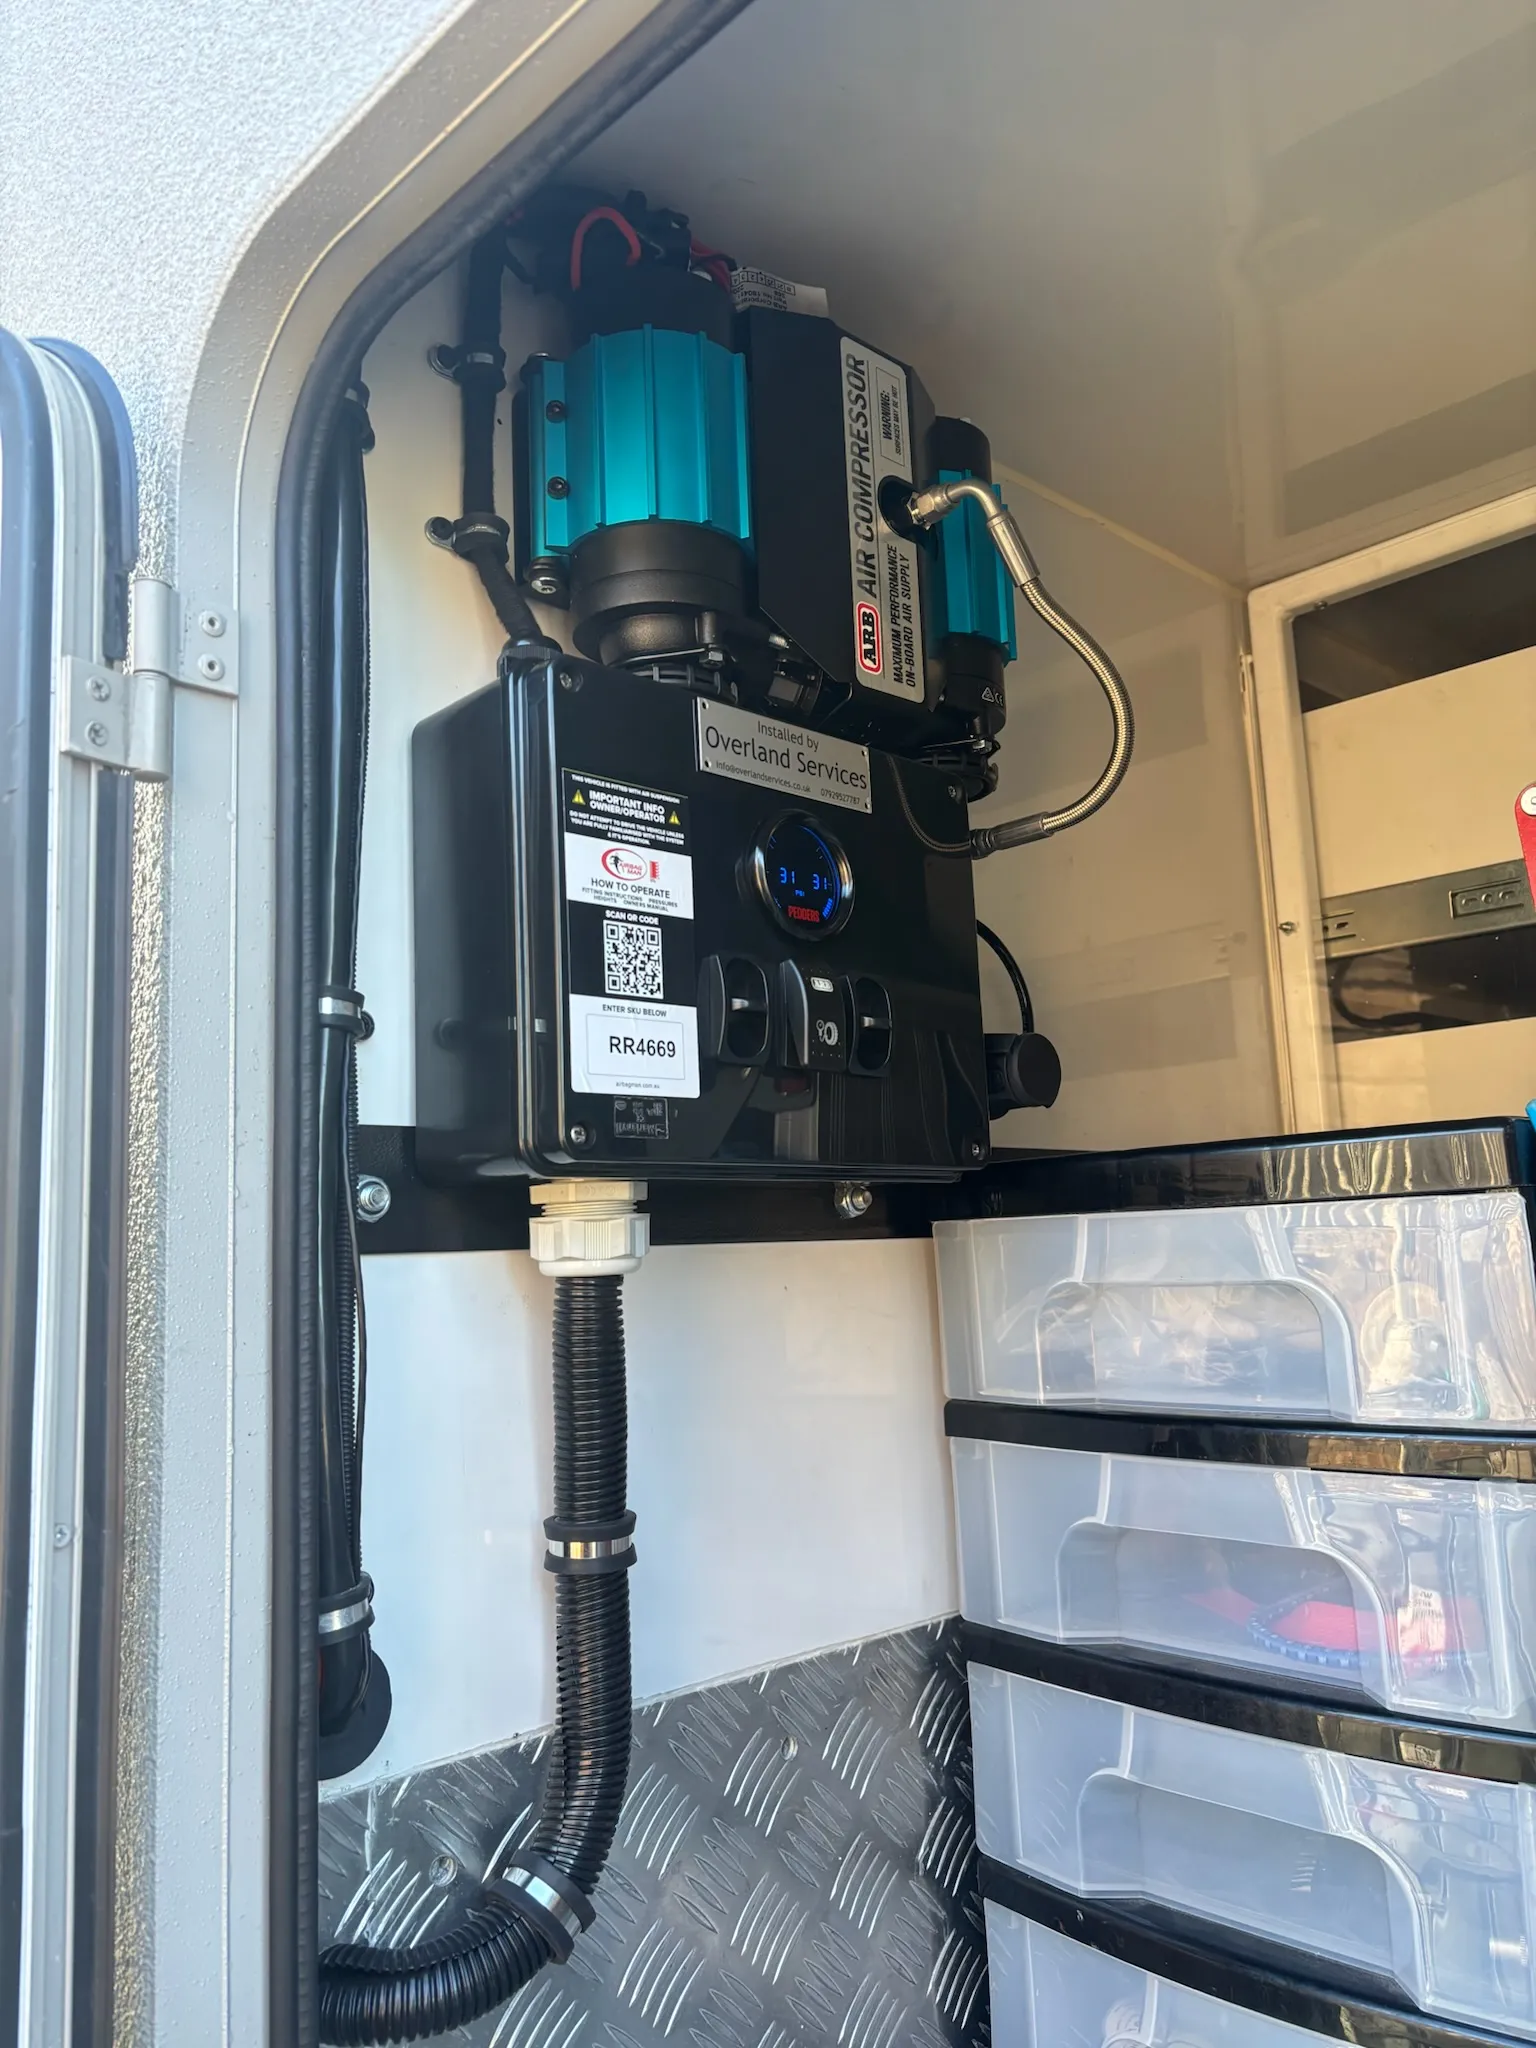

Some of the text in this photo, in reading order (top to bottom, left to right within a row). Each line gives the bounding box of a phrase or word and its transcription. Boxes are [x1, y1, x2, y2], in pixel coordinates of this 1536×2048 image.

[773, 301, 787, 311] ARB
[891, 385, 899, 397] HOT
[880, 390, 892, 441] WARNING:
[892, 407, 900, 422] MAY
[894, 424, 902, 455] SURFACES
[846, 353, 877, 666] ARB AIR COMPRESSOR
[887, 544, 904, 684] MAXIMUM PERFORMANCE
[900, 553, 916, 687] ON-BOARD AIR SUPPLY
[757, 720, 819, 752] Installed by
[706, 726, 867, 790] Overland Services
[571, 774, 584, 783] THIS
[585, 776, 605, 788] VEHICLE
[611, 783, 628, 792] FITTED
[629, 786, 641, 795] WITH
[642, 789, 650, 797] AIR
[589, 789, 665, 815] IMPORTANT INFO
[589, 800, 665, 824] OWNER/OPERATOR
[571, 817, 582, 825] YOU
[583, 819, 593, 828] ARE
[593, 821, 609, 831] FULLY
[643, 831, 655, 839] WITH
[655, 834, 665, 842] THE
[665, 835, 684, 845] SYSTEM
[578, 812, 590, 820] NOT
[590, 813, 613, 825] ATTEMPT
[613, 818, 620, 826] TO
[621, 820, 636, 829] DRIVE
[636, 823, 646, 831] THE
[646, 824, 666, 835] VEHICLE
[666, 829, 685, 839] UNLESS
[619, 862, 642, 871] AIRBAG
[627, 868, 642, 876] MAN
[591, 877, 670, 899] HOW TO OPERATE
[780, 867, 827, 890] 31 31
[582, 887, 678, 908] FITTING INSTRUCTIONS PRESSURES
[593, 895, 669, 912] HEIGHTS OWNERS MANUAL
[605, 910, 659, 925] SCAN QR CODE
[787, 905, 820, 923] PEDDERS
[602, 1004, 667, 1017] ENTER SKU BELOW
[609, 1035, 676, 1058] RR4669
